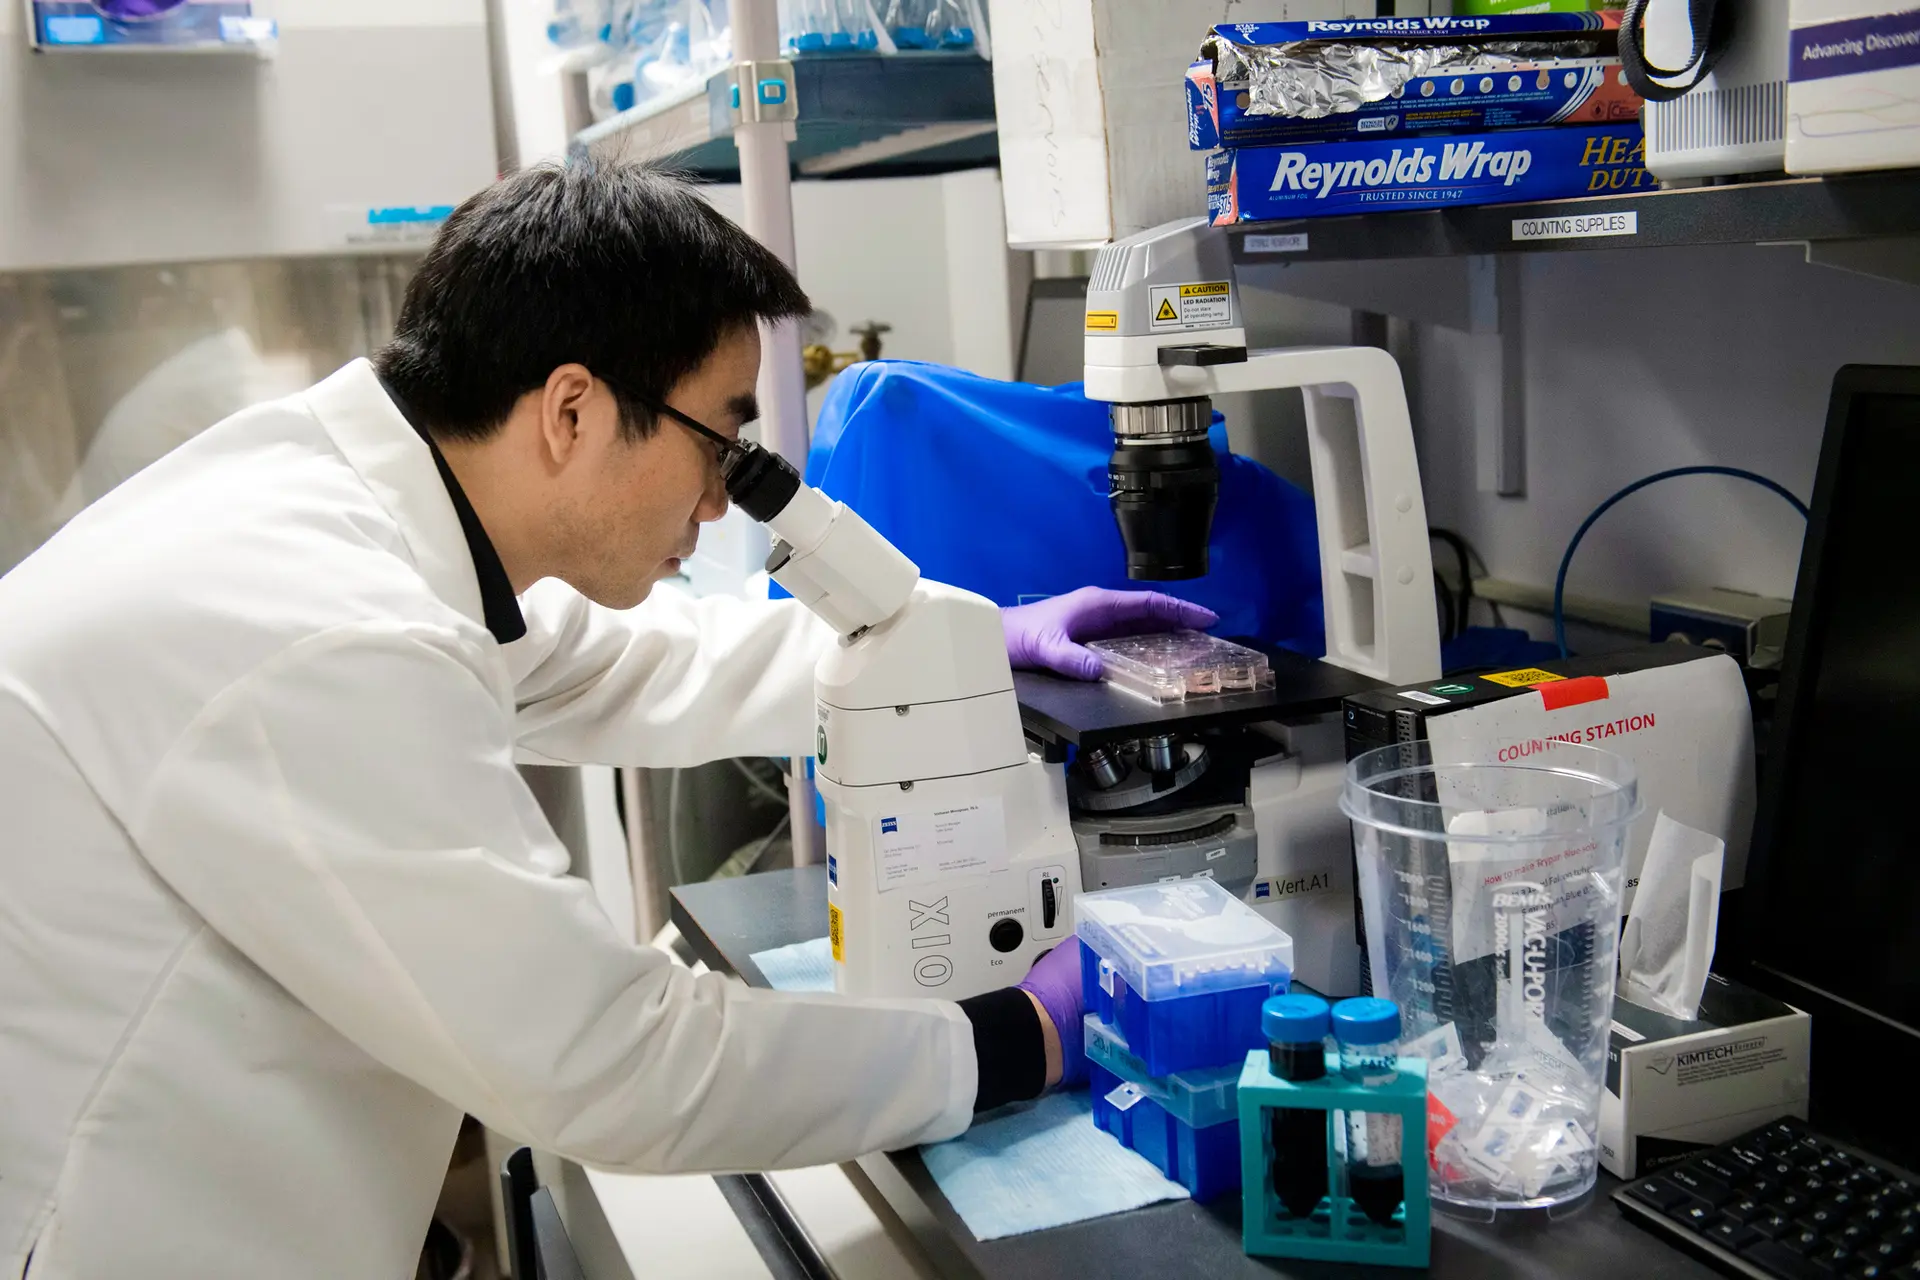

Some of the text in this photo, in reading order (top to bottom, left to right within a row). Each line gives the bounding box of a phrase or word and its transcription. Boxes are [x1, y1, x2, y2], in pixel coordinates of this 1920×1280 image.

[1308, 17, 1490, 34] Reynolds Wrap
[1802, 38, 1864, 61] Advancing
[1208, 153, 1230, 169] Reynolds
[1579, 136, 1645, 166] HEA
[1268, 141, 1532, 199] Reynolds Wrap
[1360, 190, 1463, 201] TRUSTED SINCE 1947
[1522, 216, 1626, 236] COUNTING SUPPLIES
[1192, 284, 1226, 294] CAUTION
[817, 732, 826, 754] 17
[1498, 713, 1656, 763] COUNTING STATION
[1276, 872, 1329, 896] Vert.A1
[1484, 874, 1503, 886] How
[1504, 870, 1512, 879] to
[1514, 863, 1534, 876] make
[987, 907, 1026, 919] permanent
[990, 958, 1004, 967] Eco
[1677, 1045, 1734, 1067] KIMTECH
